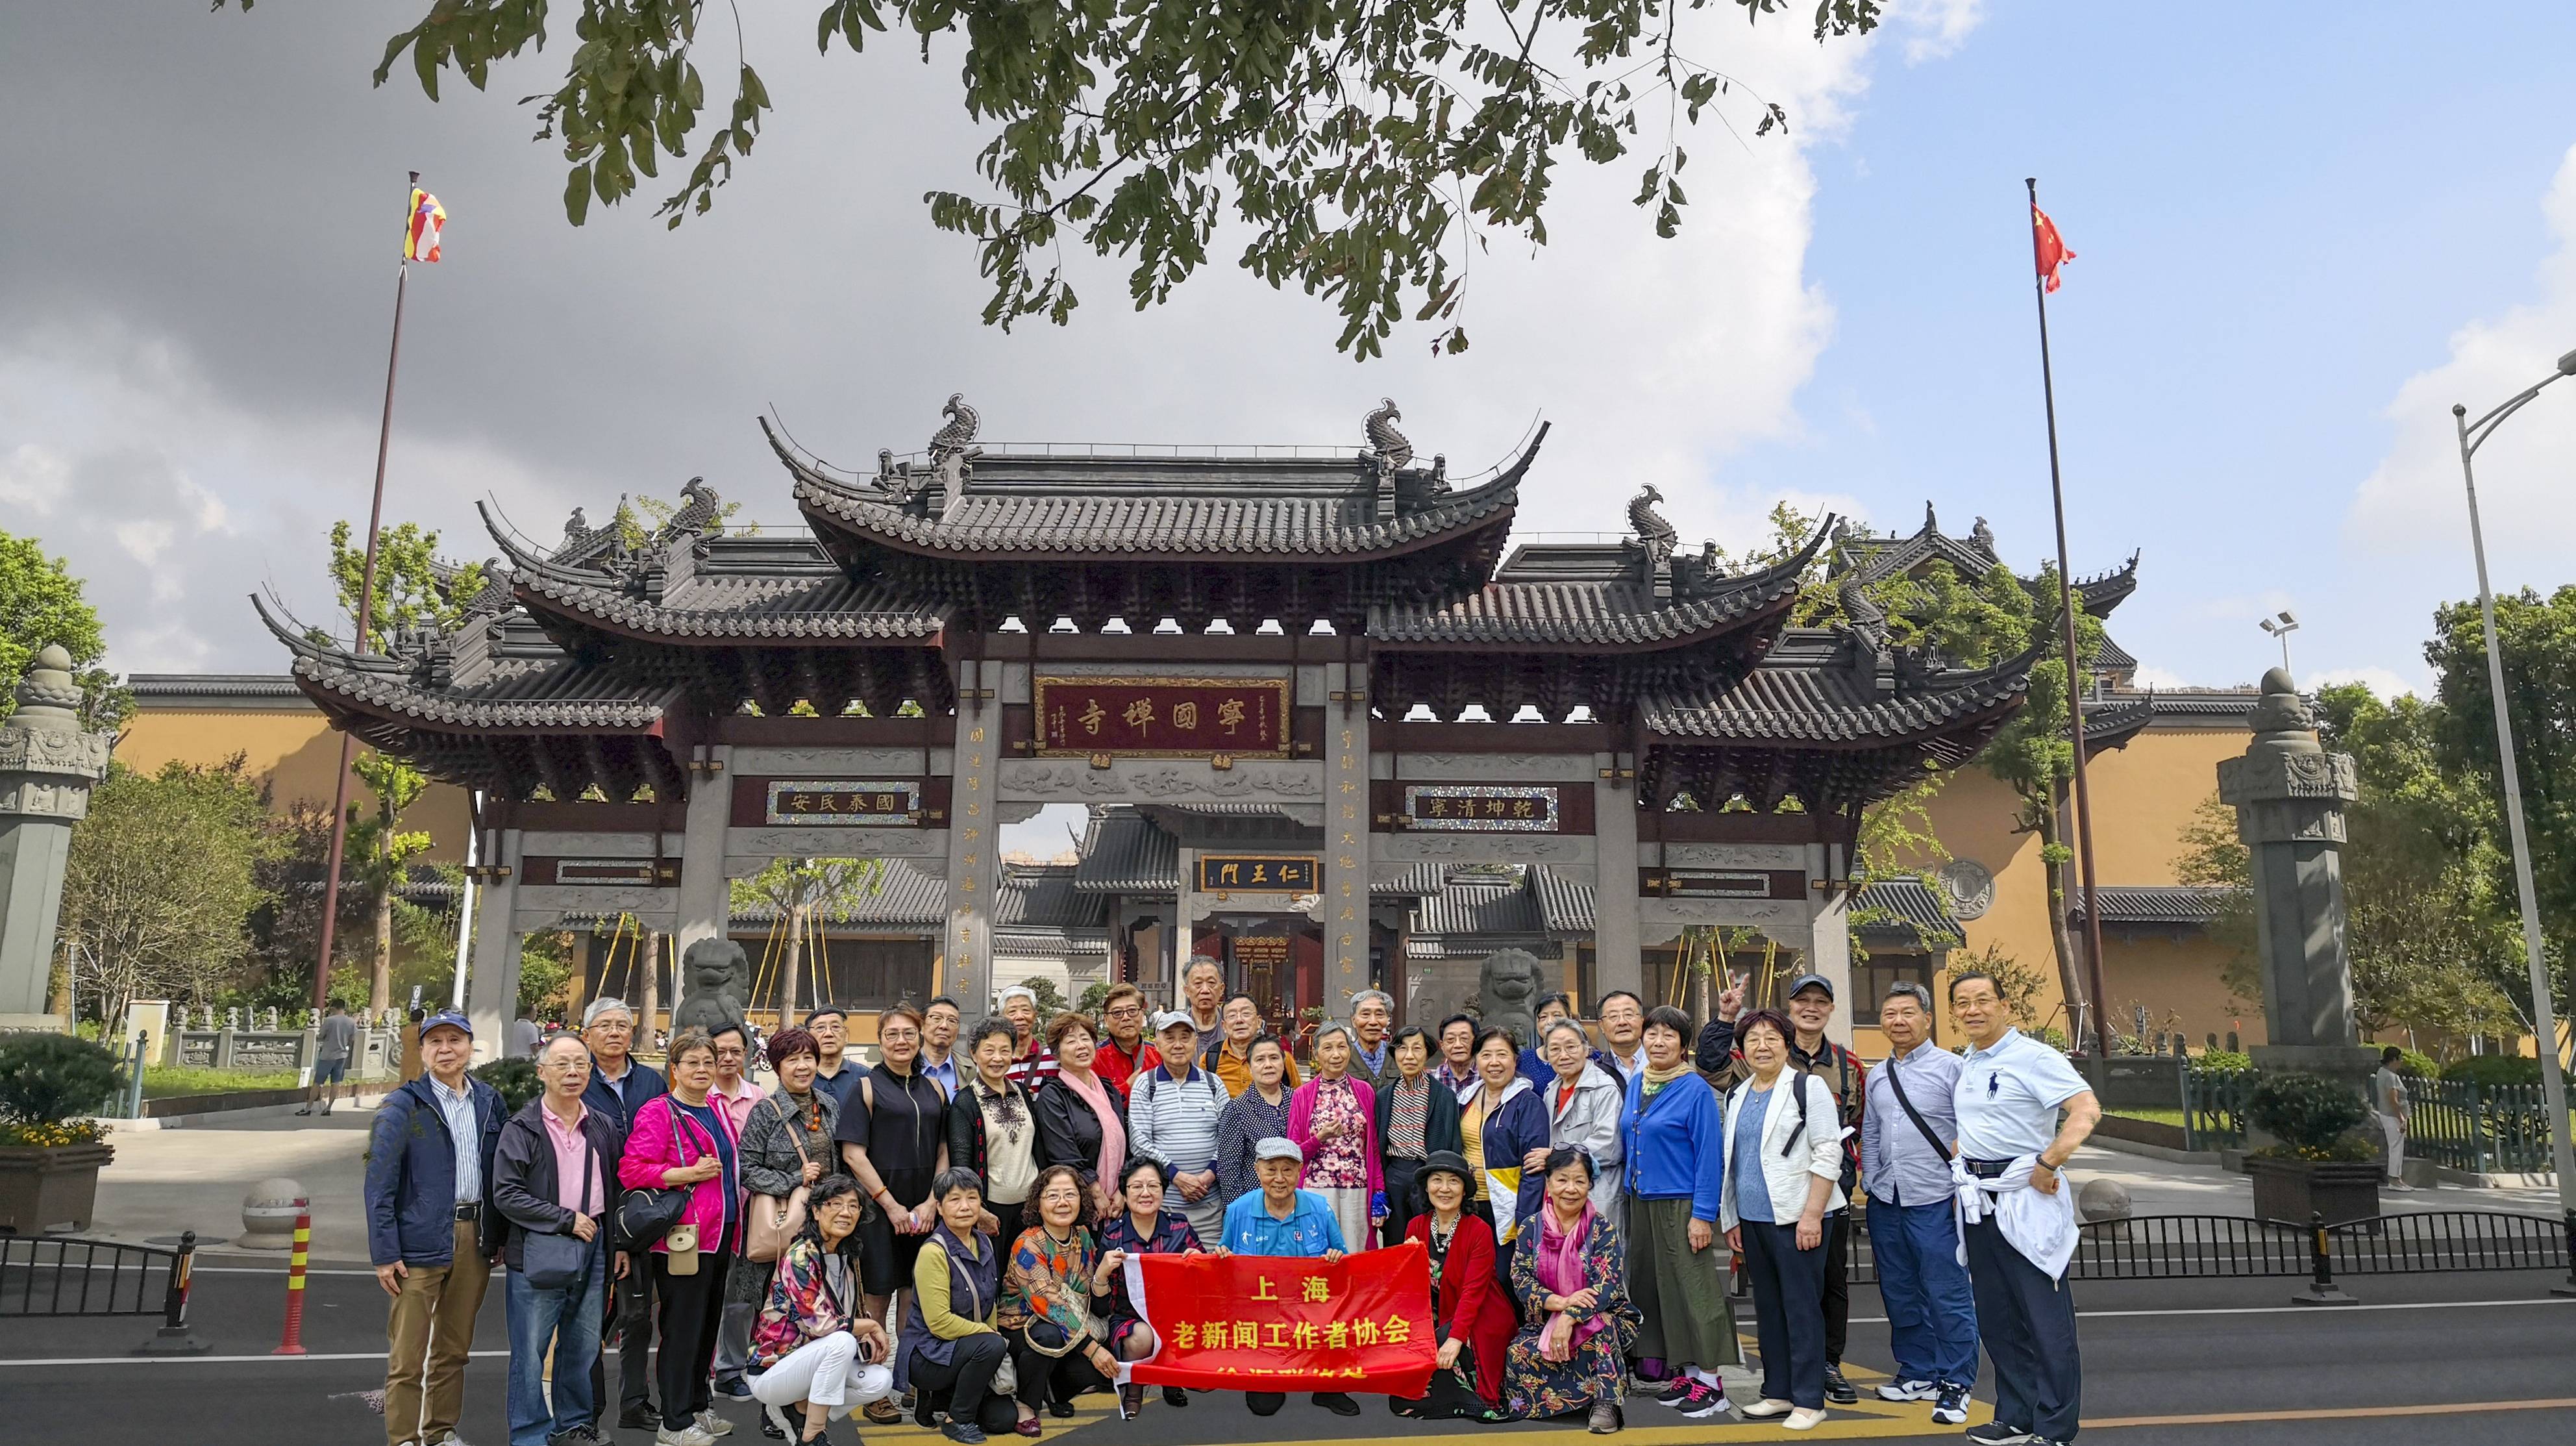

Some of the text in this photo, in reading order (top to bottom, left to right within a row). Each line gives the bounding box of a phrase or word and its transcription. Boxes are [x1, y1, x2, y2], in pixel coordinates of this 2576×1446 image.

[791, 793, 895, 812] 國泰民安
[1429, 798, 1535, 818] 乾坤清寧
[1220, 863, 1300, 884] 仁王門
[1172, 1314, 1411, 1350] 老新闻工作者协会
